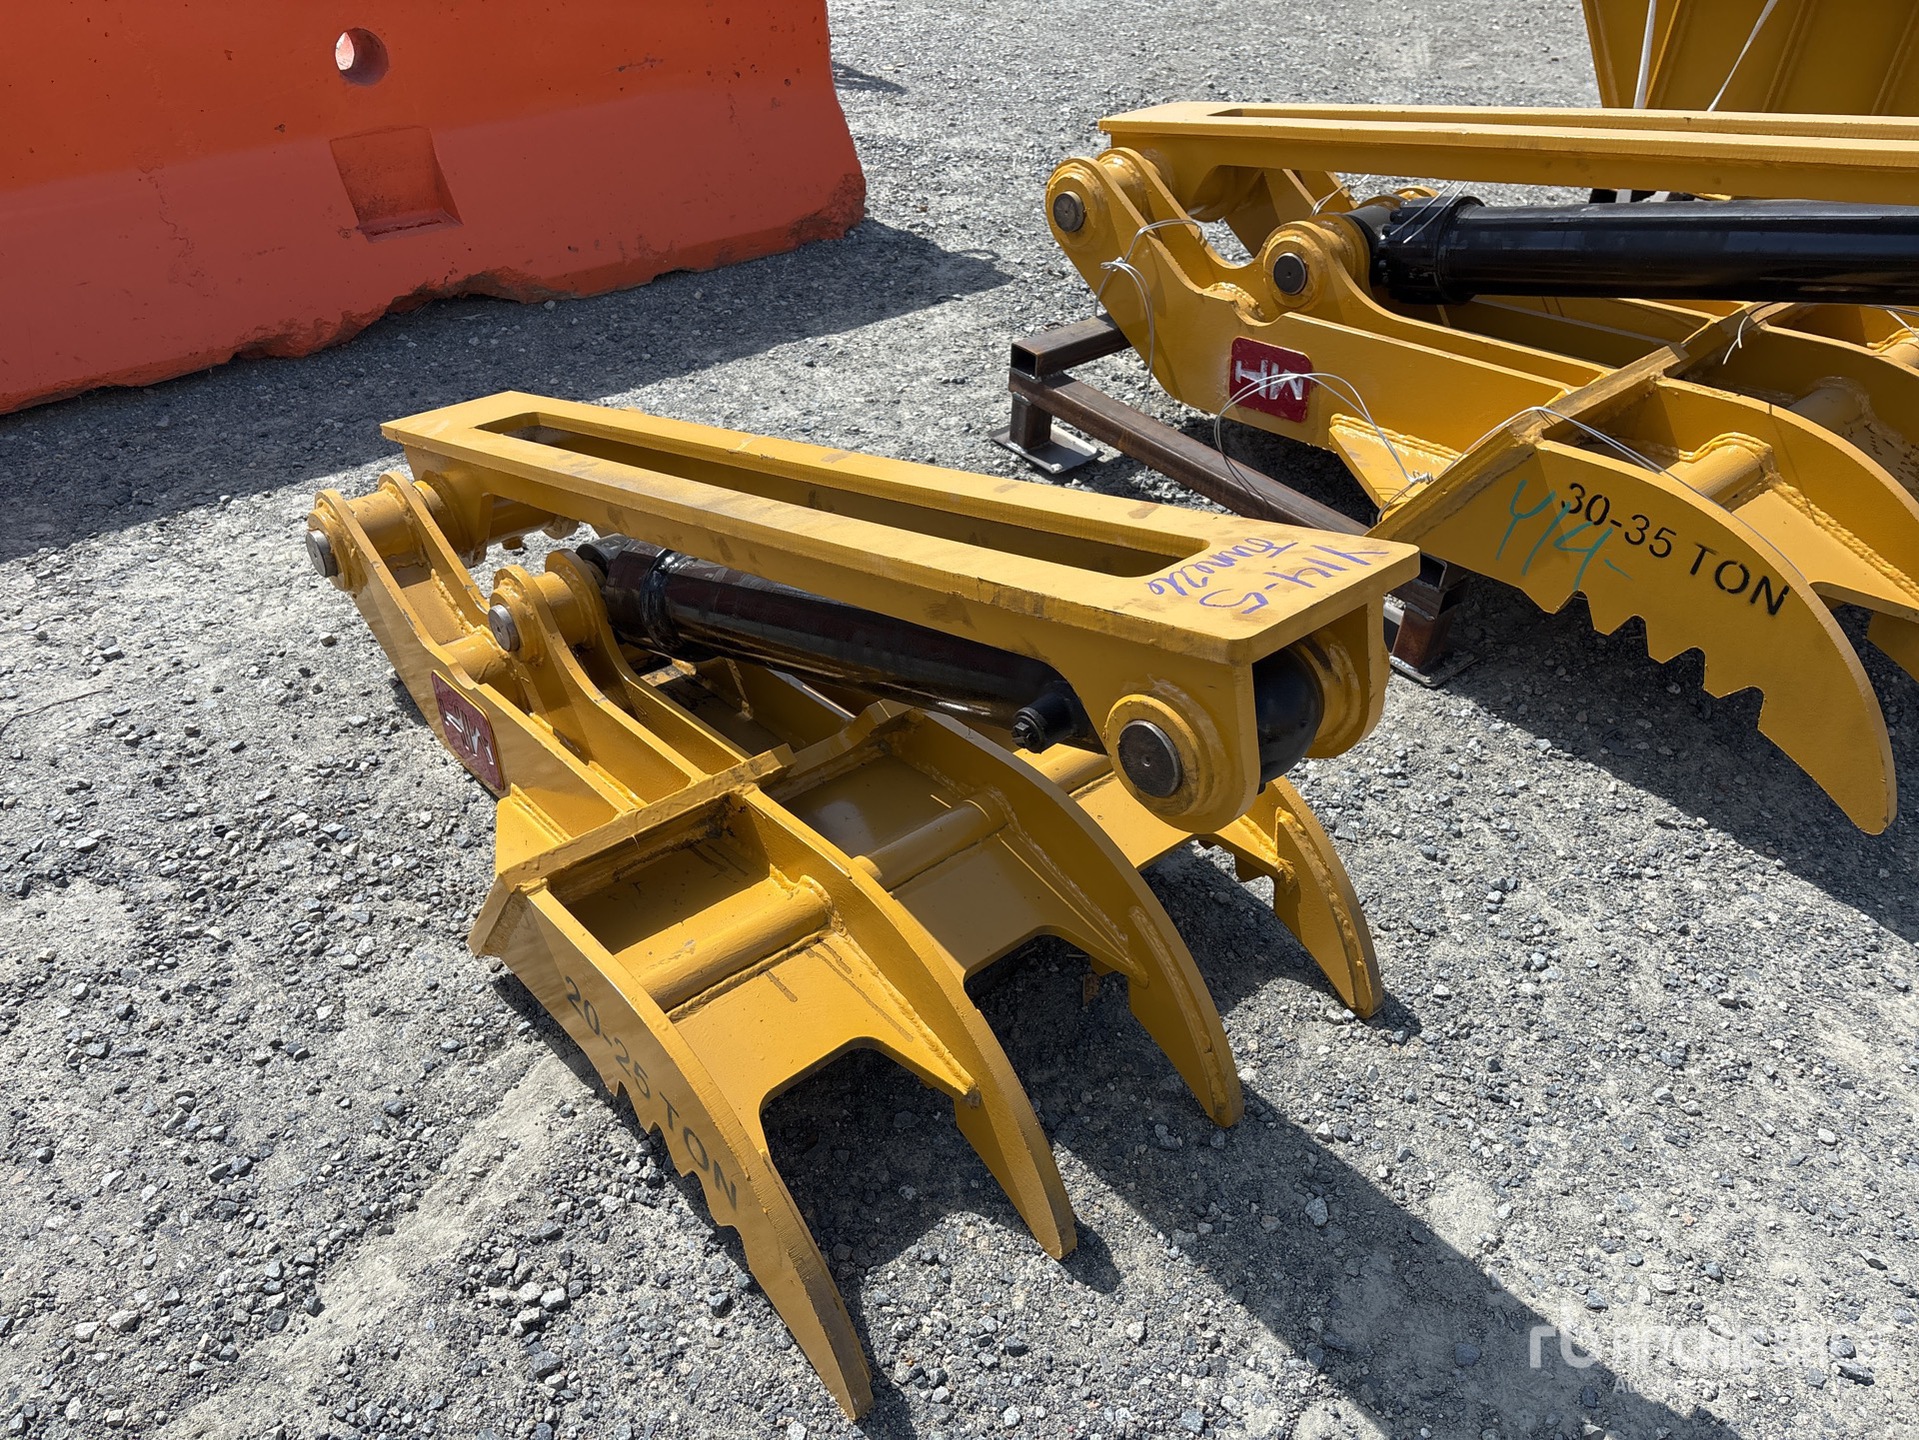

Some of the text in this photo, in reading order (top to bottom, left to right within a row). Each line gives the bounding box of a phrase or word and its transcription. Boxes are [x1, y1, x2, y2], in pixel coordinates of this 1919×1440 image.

[1561, 482, 1790, 616] 30-35 TON
[565, 975, 737, 1211] 20-25 TON
